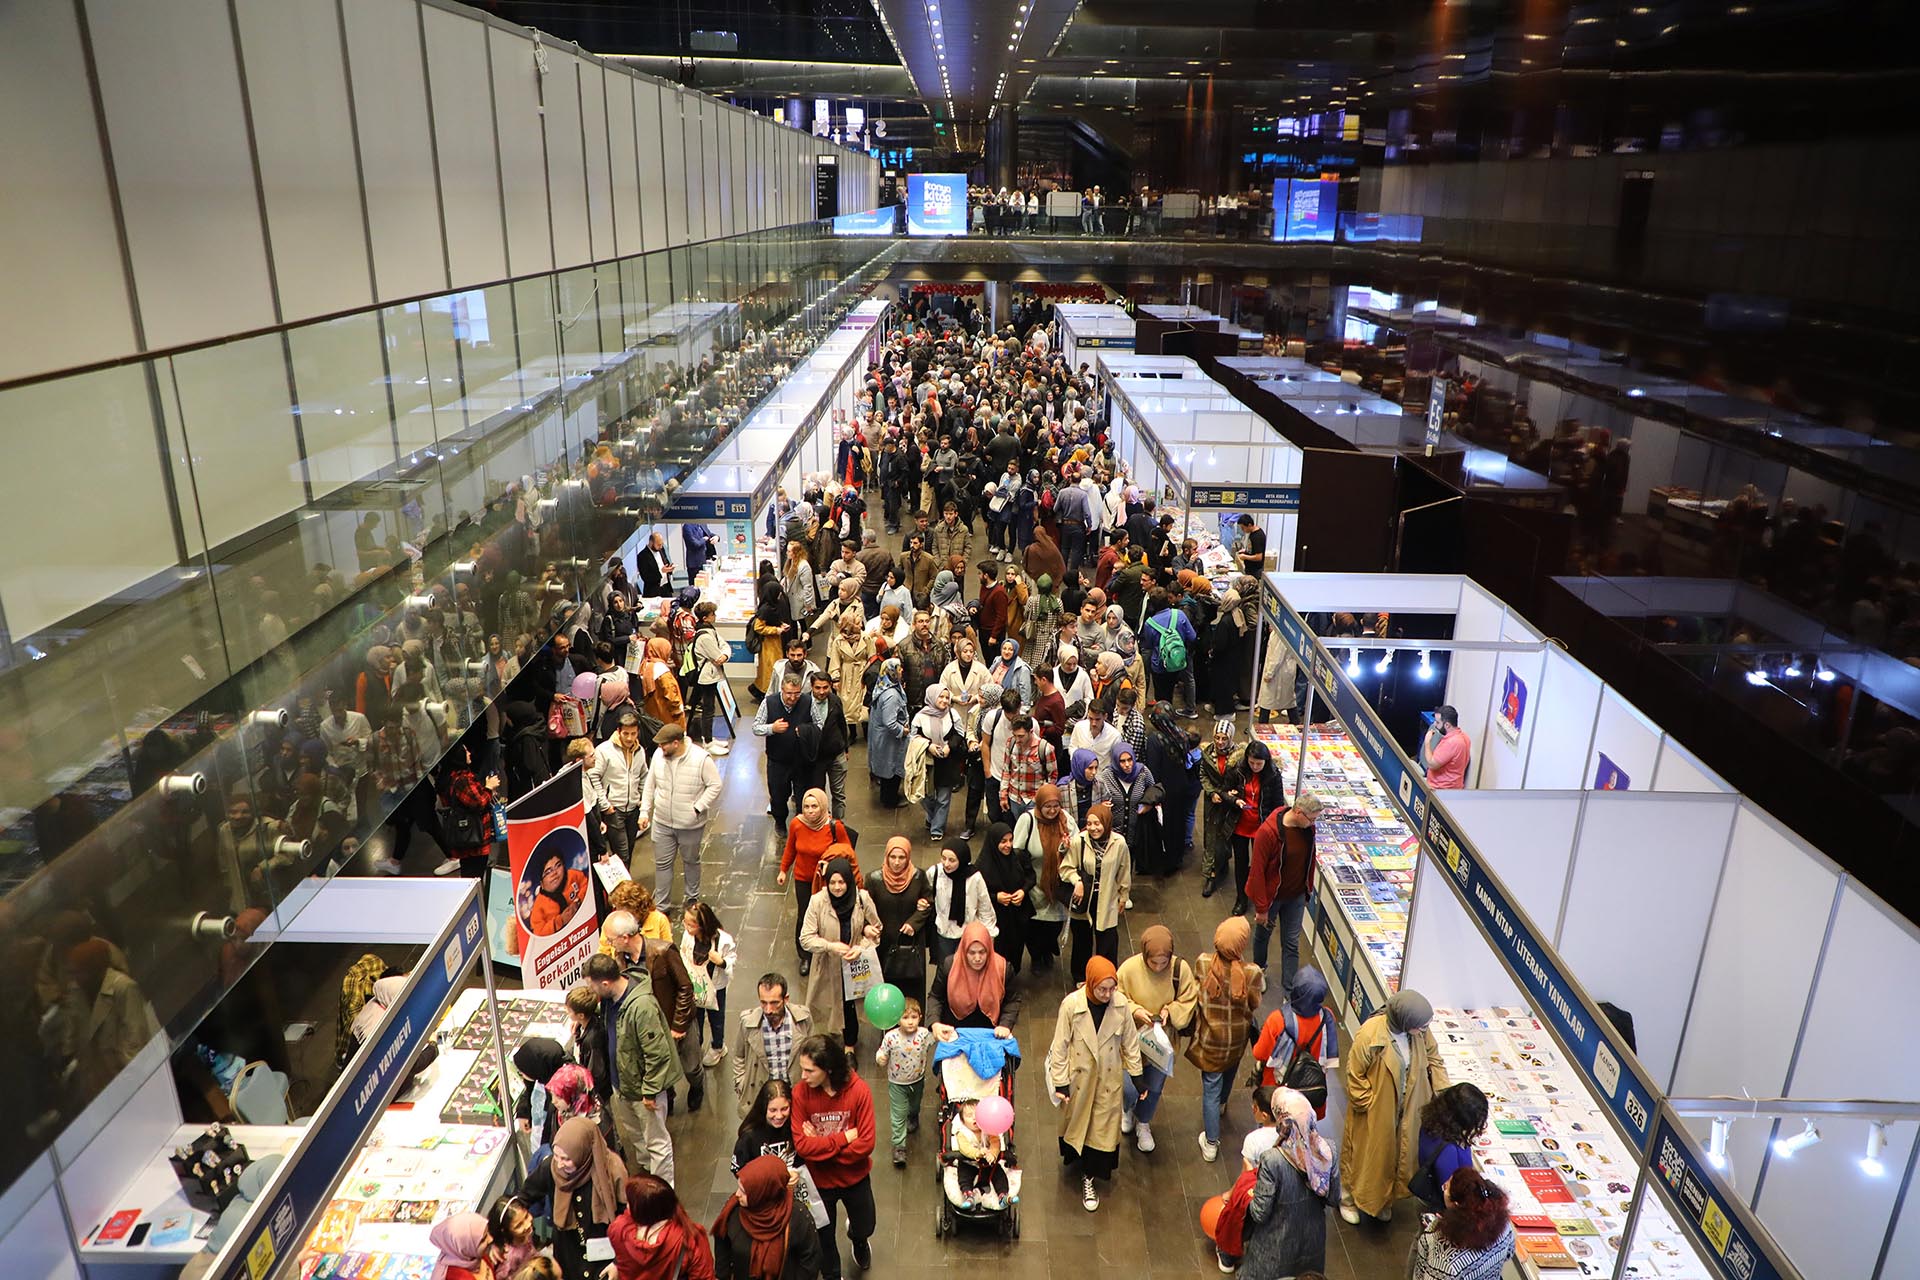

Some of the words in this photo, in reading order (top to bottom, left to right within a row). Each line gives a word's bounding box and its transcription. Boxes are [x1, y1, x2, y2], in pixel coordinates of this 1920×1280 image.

[537, 941, 568, 970] Engelsiz
[568, 926, 589, 945] Yazar
[540, 956, 575, 989] Berkan
[578, 941, 591, 961] Ali
[1475, 882, 1496, 917] KANON
[1495, 909, 1514, 939] KİTAP
[1516, 940, 1548, 988] LİTERART
[1548, 981, 1585, 1042] YAYINLARI
[560, 963, 585, 990] VUR
[355, 1073, 380, 1115] LAKİN
[378, 1016, 412, 1077] YAYINEVİ
[1599, 1050, 1616, 1077] KANON
[1627, 1099, 1644, 1128] 326
[1661, 1143, 1683, 1179] kitap
[1664, 1135, 1685, 1170] konya
